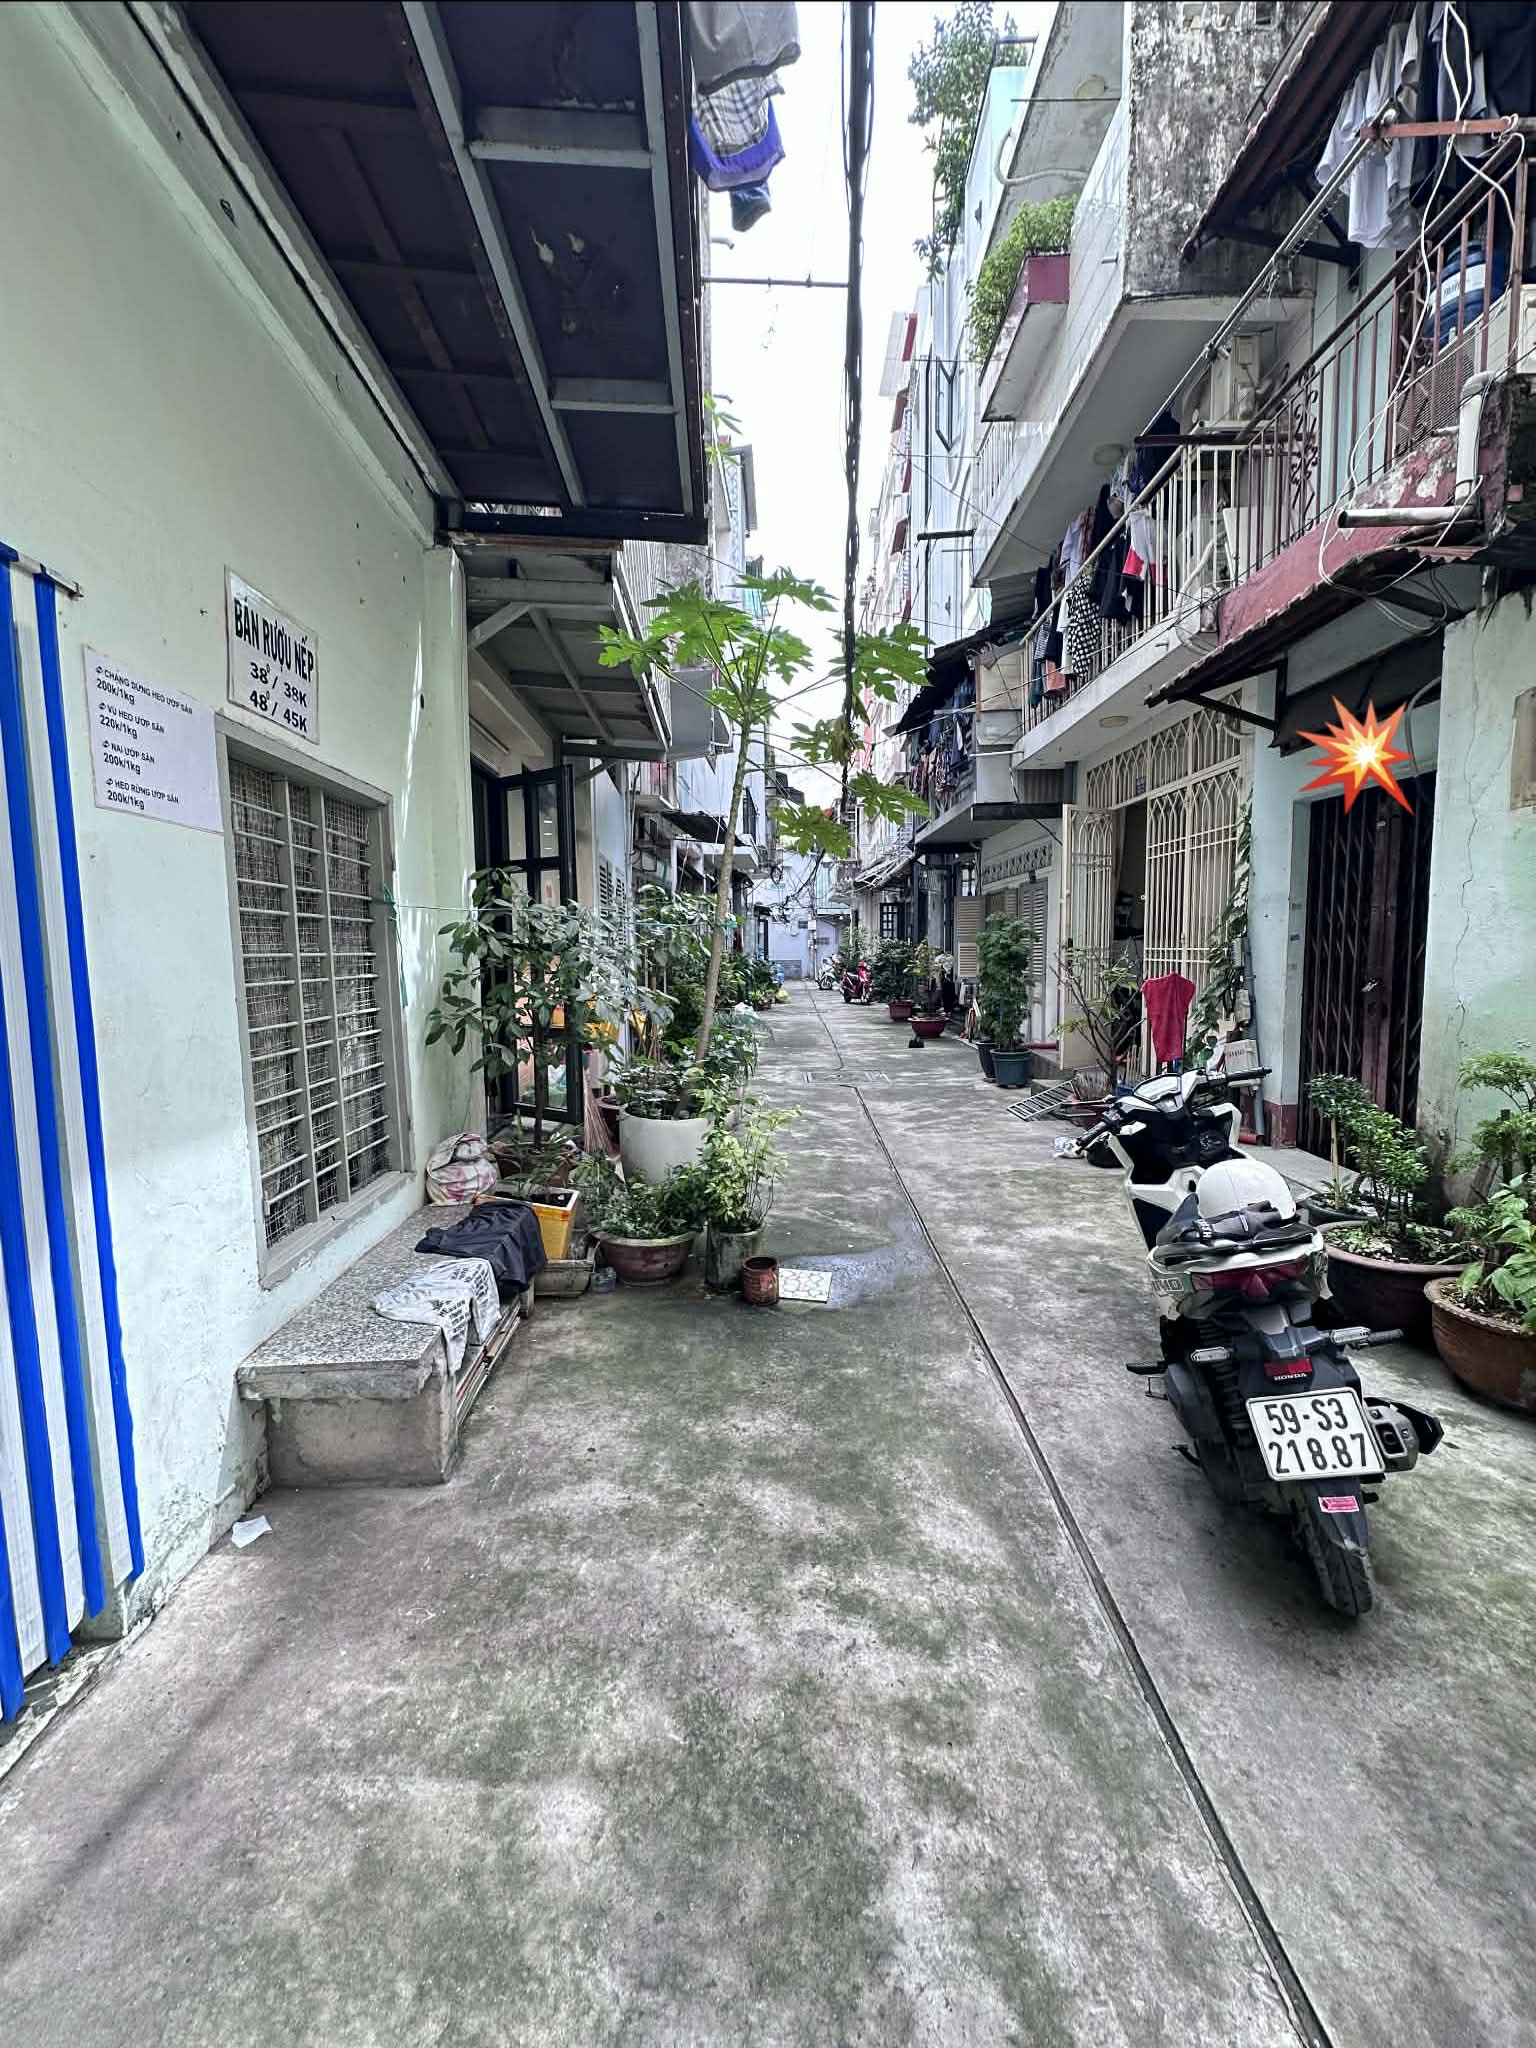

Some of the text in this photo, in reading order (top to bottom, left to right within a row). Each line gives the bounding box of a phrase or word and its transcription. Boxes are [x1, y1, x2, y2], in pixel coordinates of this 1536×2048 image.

[234, 596, 314, 682] BÁN RƯỢU NẾP
[97, 678, 135, 705] 200k/1kg
[151, 690, 166, 703] HEO
[283, 682, 307, 708] 38K
[99, 714, 138, 740] 220k/1kg
[118, 709, 134, 722] HEO
[283, 708, 307, 732] 45K
[103, 752, 141, 776] 200k/1kg
[114, 779, 130, 791] HEO
[107, 789, 145, 811] 200k/1kg
[1273, 1372, 1308, 1382] HONDA
[1264, 1397, 1348, 1436] 59-S3
[1268, 1432, 1368, 1474] 218.87
